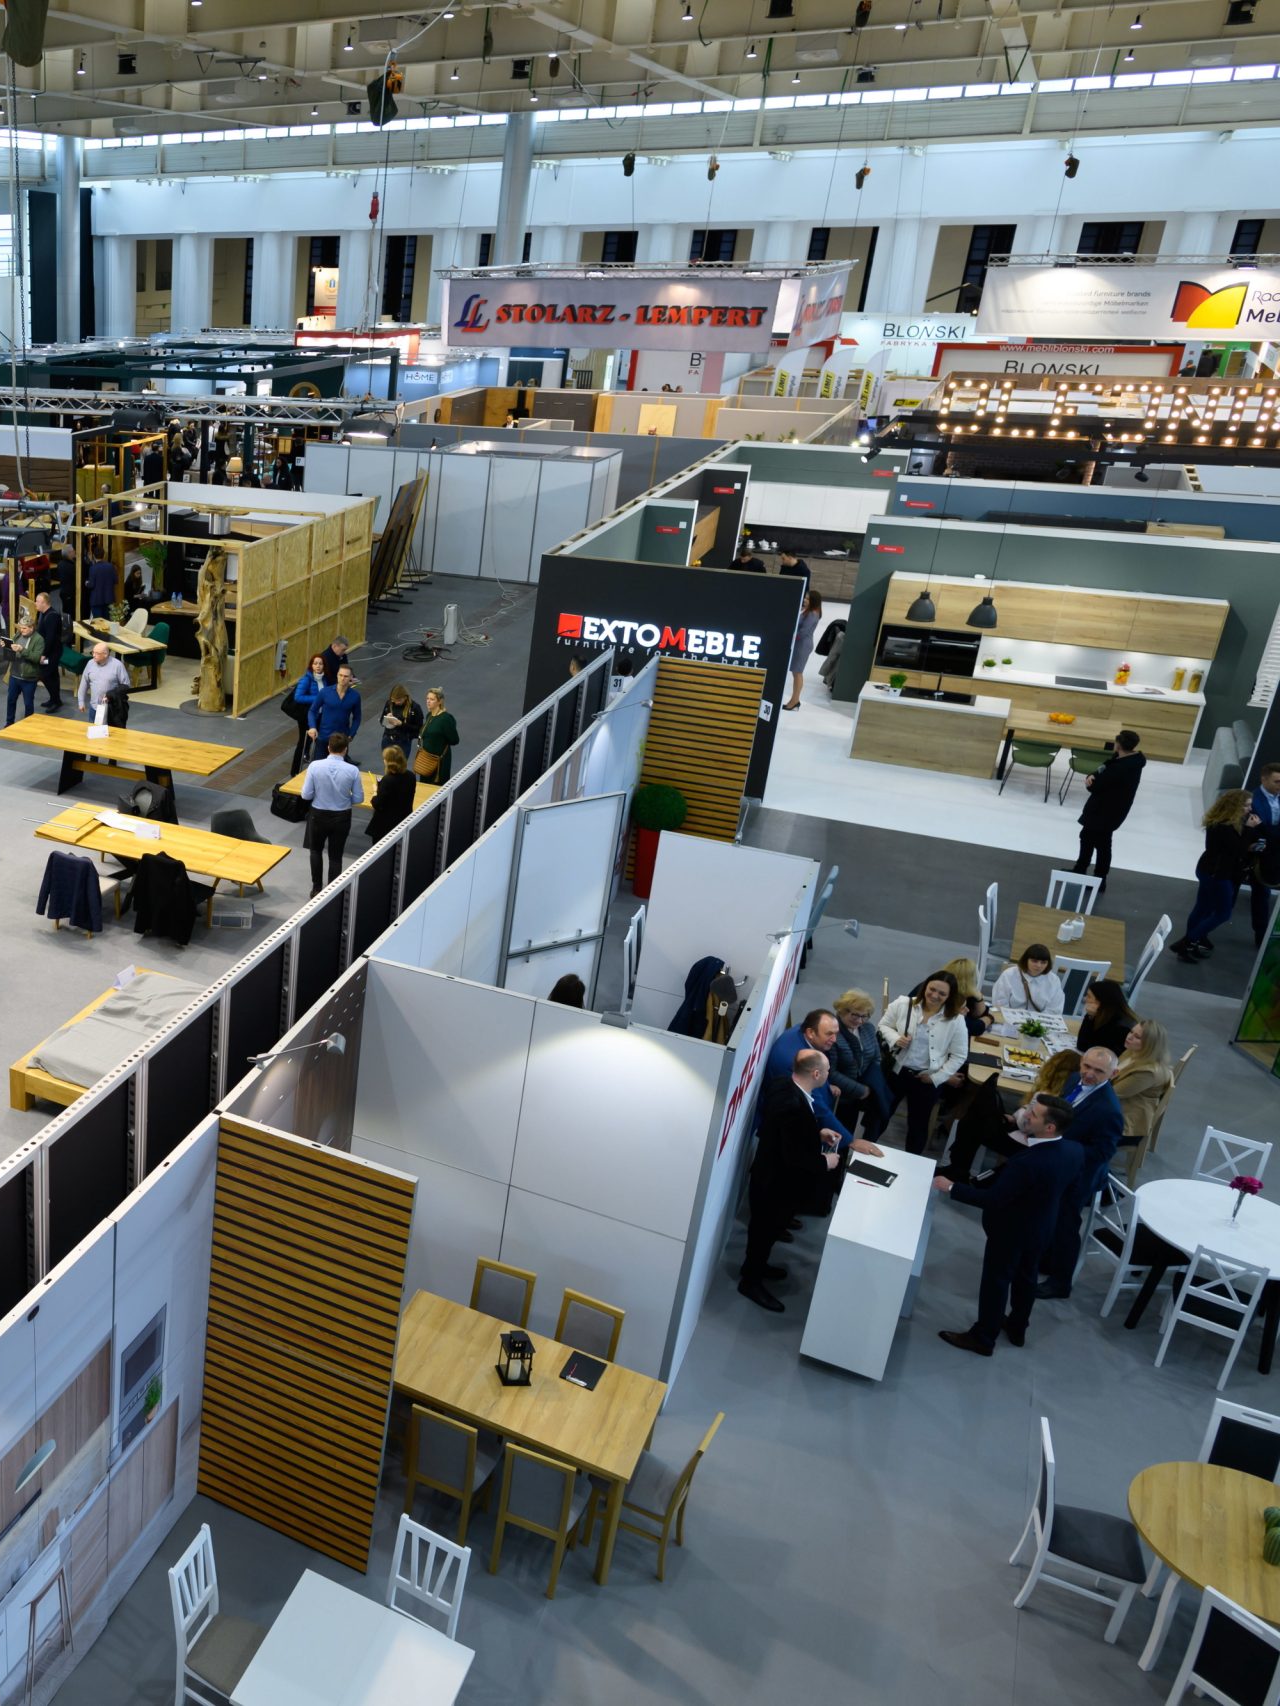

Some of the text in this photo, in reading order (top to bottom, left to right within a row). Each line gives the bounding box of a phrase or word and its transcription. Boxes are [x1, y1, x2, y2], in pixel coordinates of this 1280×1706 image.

[1126, 290, 1151, 298] brands
[496, 303, 617, 326] STOLARZ
[635, 305, 768, 328] LEMPERT
[883, 323, 966, 339] BLONSKI
[999, 344, 1115, 354] www.mebliblonski.com
[405, 371, 435, 382] HOME
[556, 636, 635, 654] furniture
[582, 616, 762, 661] EXTOMEBLE
[613, 678, 622, 688] 31
